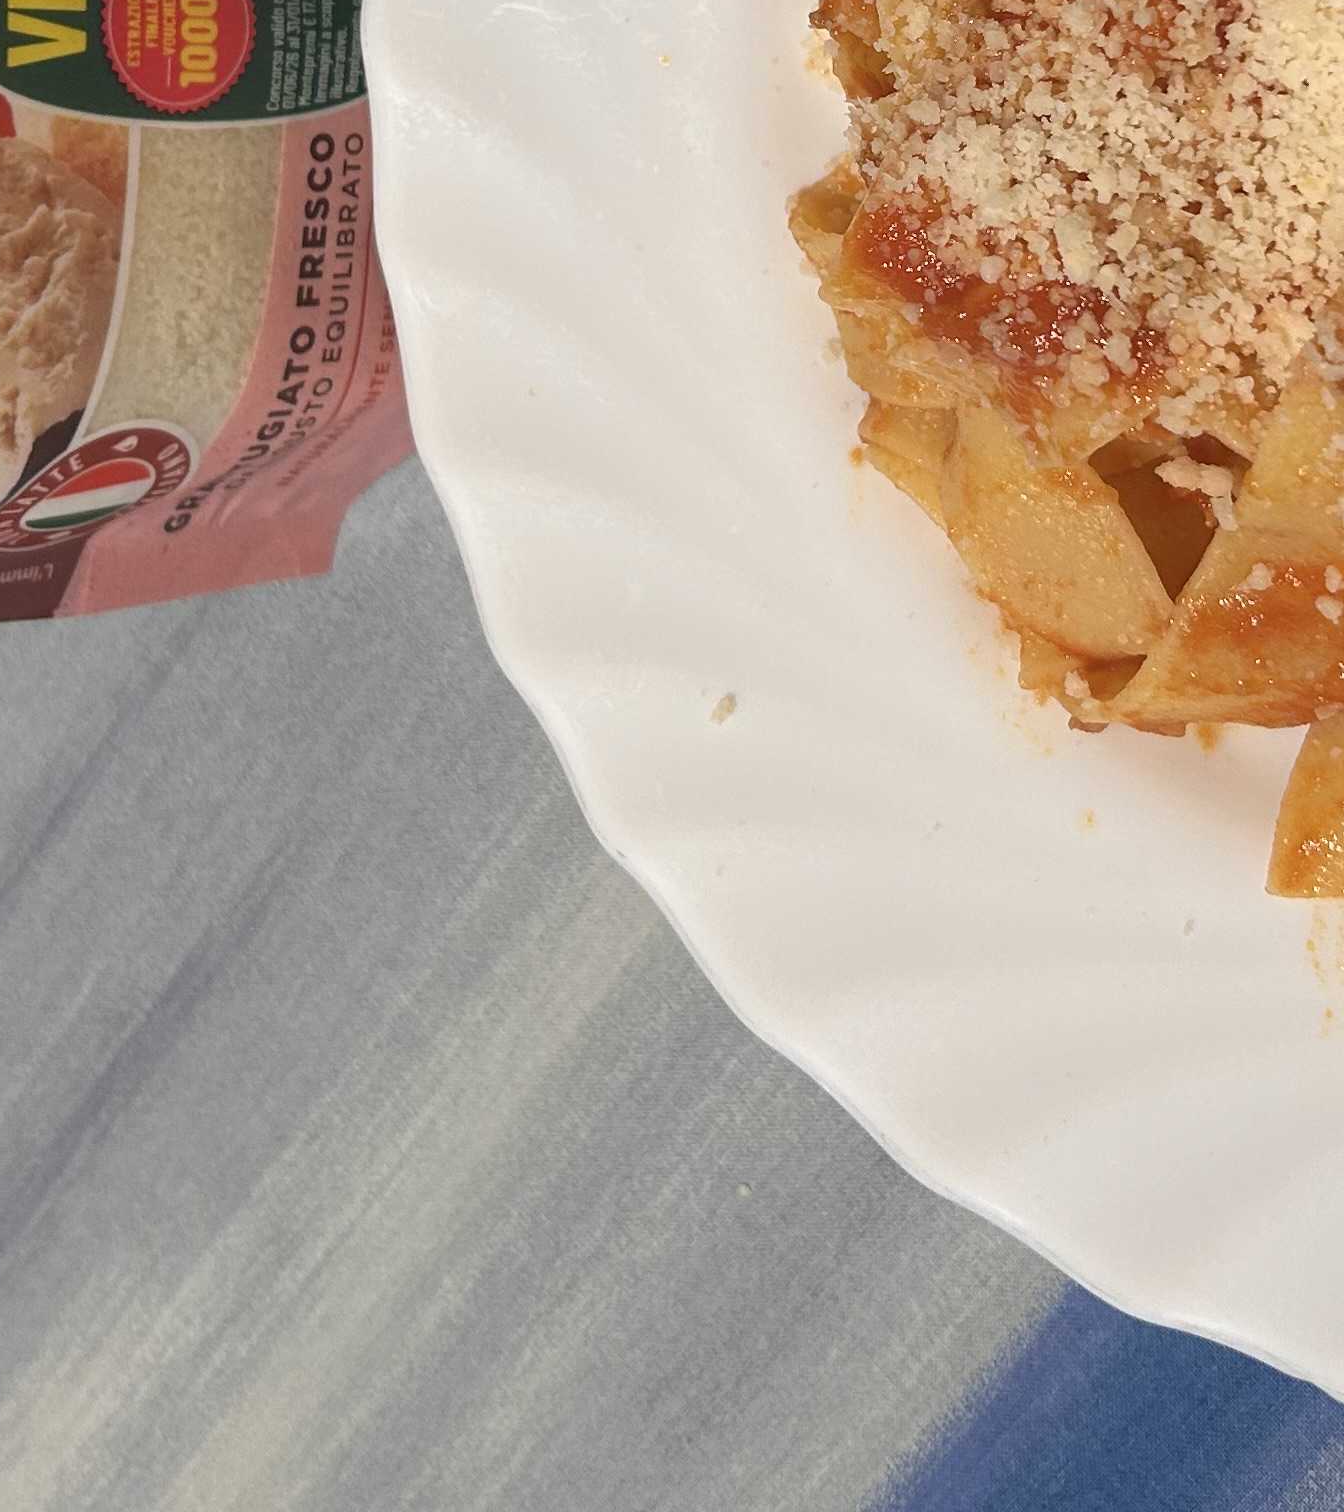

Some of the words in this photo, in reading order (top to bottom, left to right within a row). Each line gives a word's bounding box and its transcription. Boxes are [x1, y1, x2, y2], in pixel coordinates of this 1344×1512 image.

[271, 8, 285, 46] valido
[266, 50, 284, 111] Concorso
[273, 377, 333, 456] USTO
[322, 133, 364, 363] EQUILIBRATO
[163, 325, 316, 533] GRAUGIATO
[296, 133, 335, 307] FRESCO
[1, 453, 85, 515] LATTE
